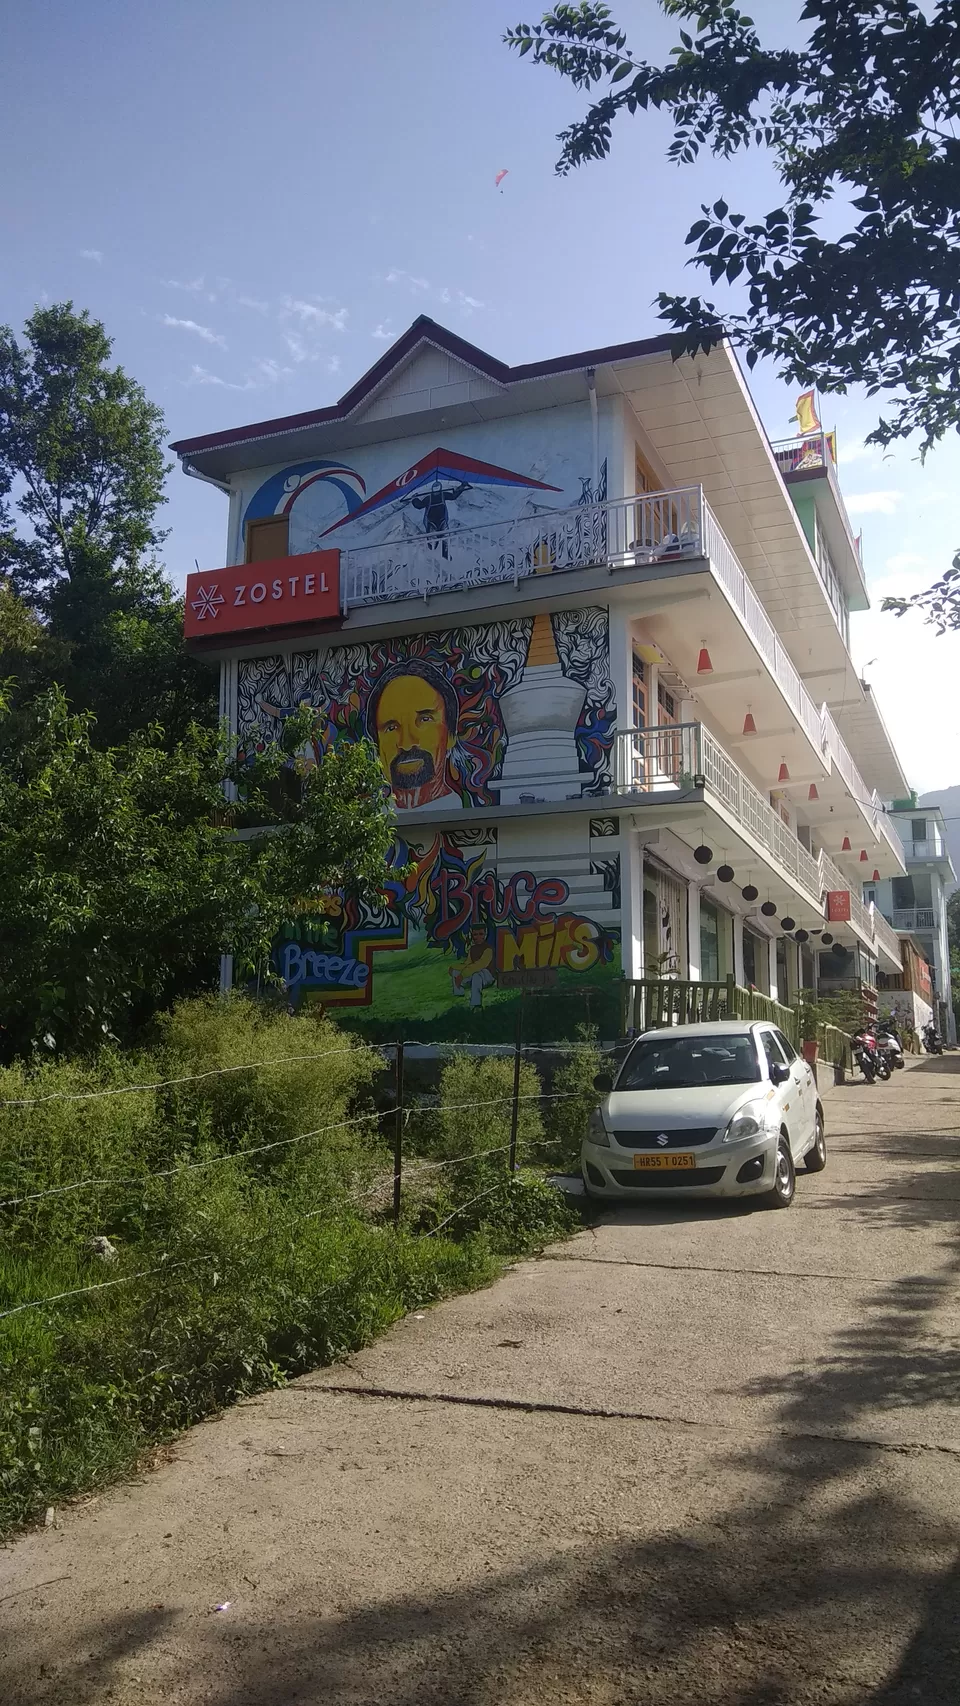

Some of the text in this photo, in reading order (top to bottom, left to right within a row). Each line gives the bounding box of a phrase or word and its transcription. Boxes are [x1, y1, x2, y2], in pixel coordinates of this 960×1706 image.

[233, 572, 329, 607] ZOSTEL
[431, 867, 572, 940] Bruce
[284, 943, 371, 989] Breeze
[640, 1156, 661, 1167] HR55
[671, 1155, 694, 1166] 0251
